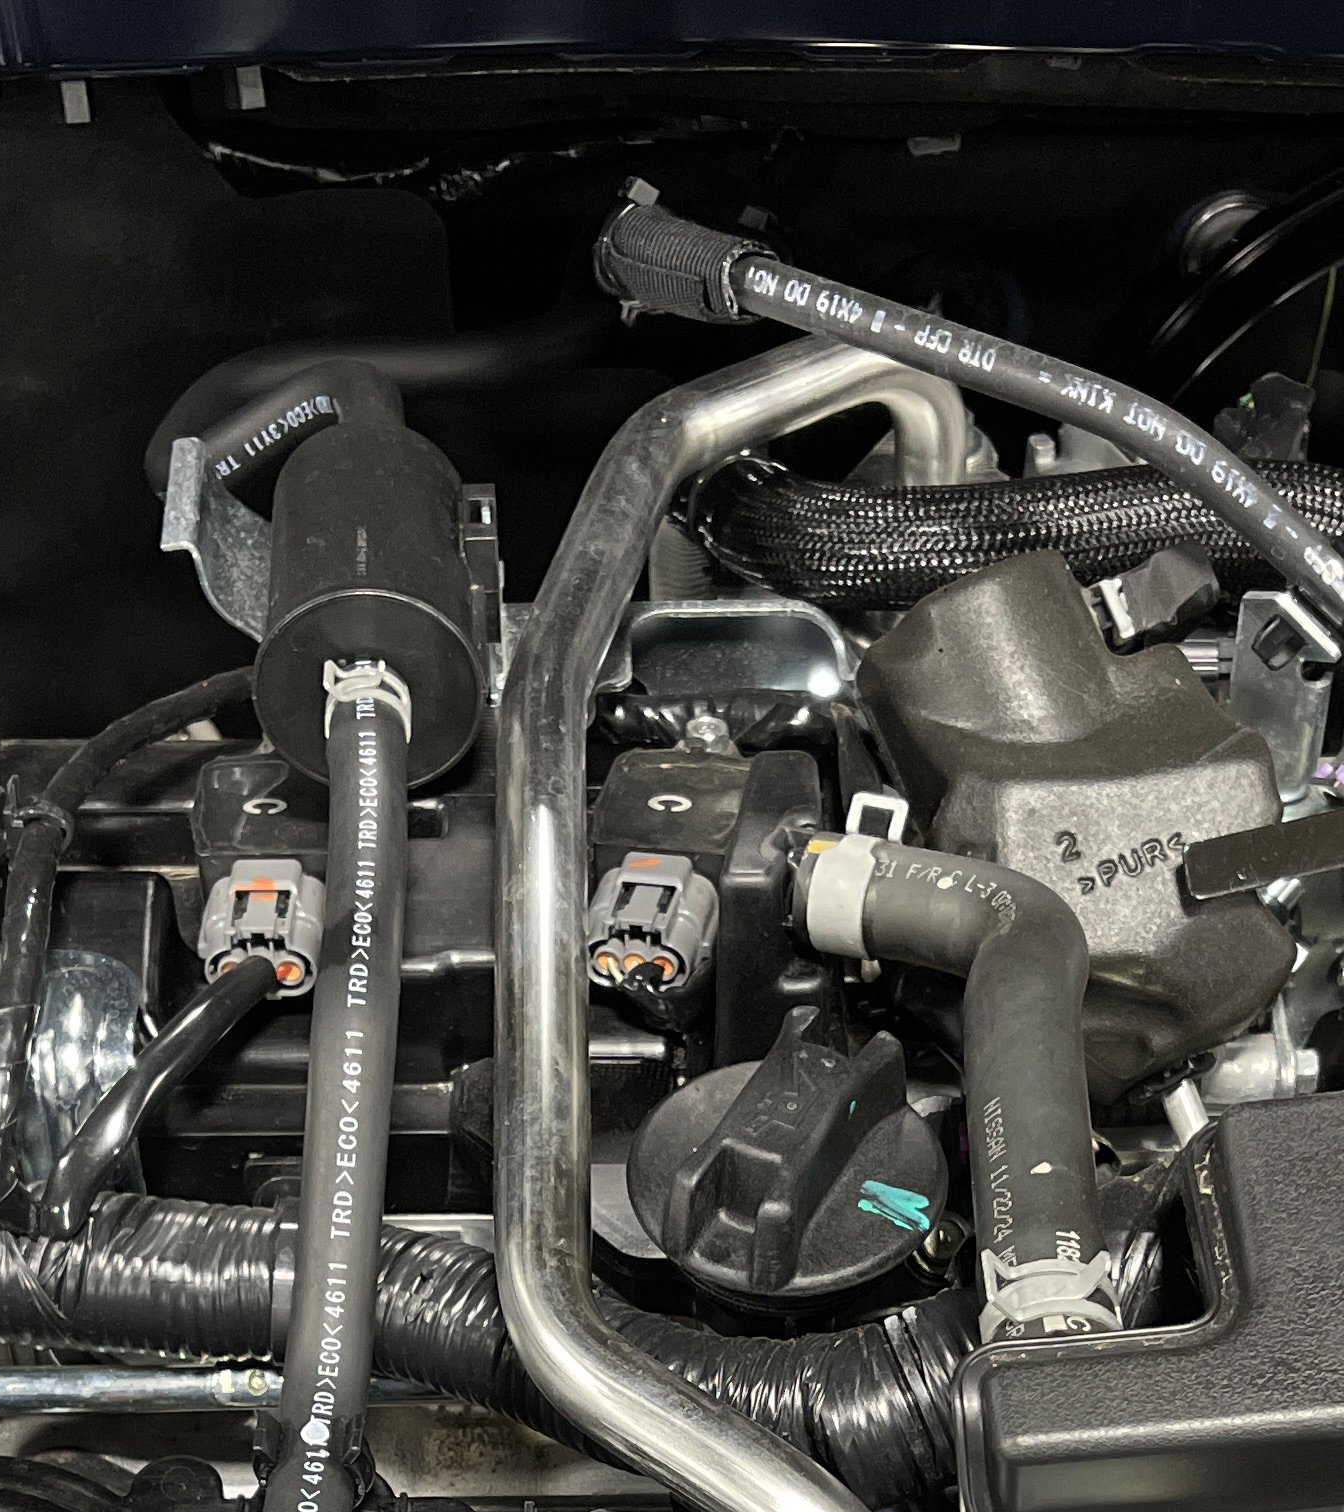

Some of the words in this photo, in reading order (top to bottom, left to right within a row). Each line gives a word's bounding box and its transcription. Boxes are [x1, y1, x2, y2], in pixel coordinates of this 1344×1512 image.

[744, 267, 779, 296] NO
[212, 455, 241, 480] TR
[356, 731, 379, 851] TRD>ECO<4611
[1056, 830, 1082, 864] 2
[346, 858, 377, 1008] TRD>ECO<4611
[330, 1030, 366, 1240] TRD>ECO<4611
[982, 1095, 1006, 1163] NISSAN
